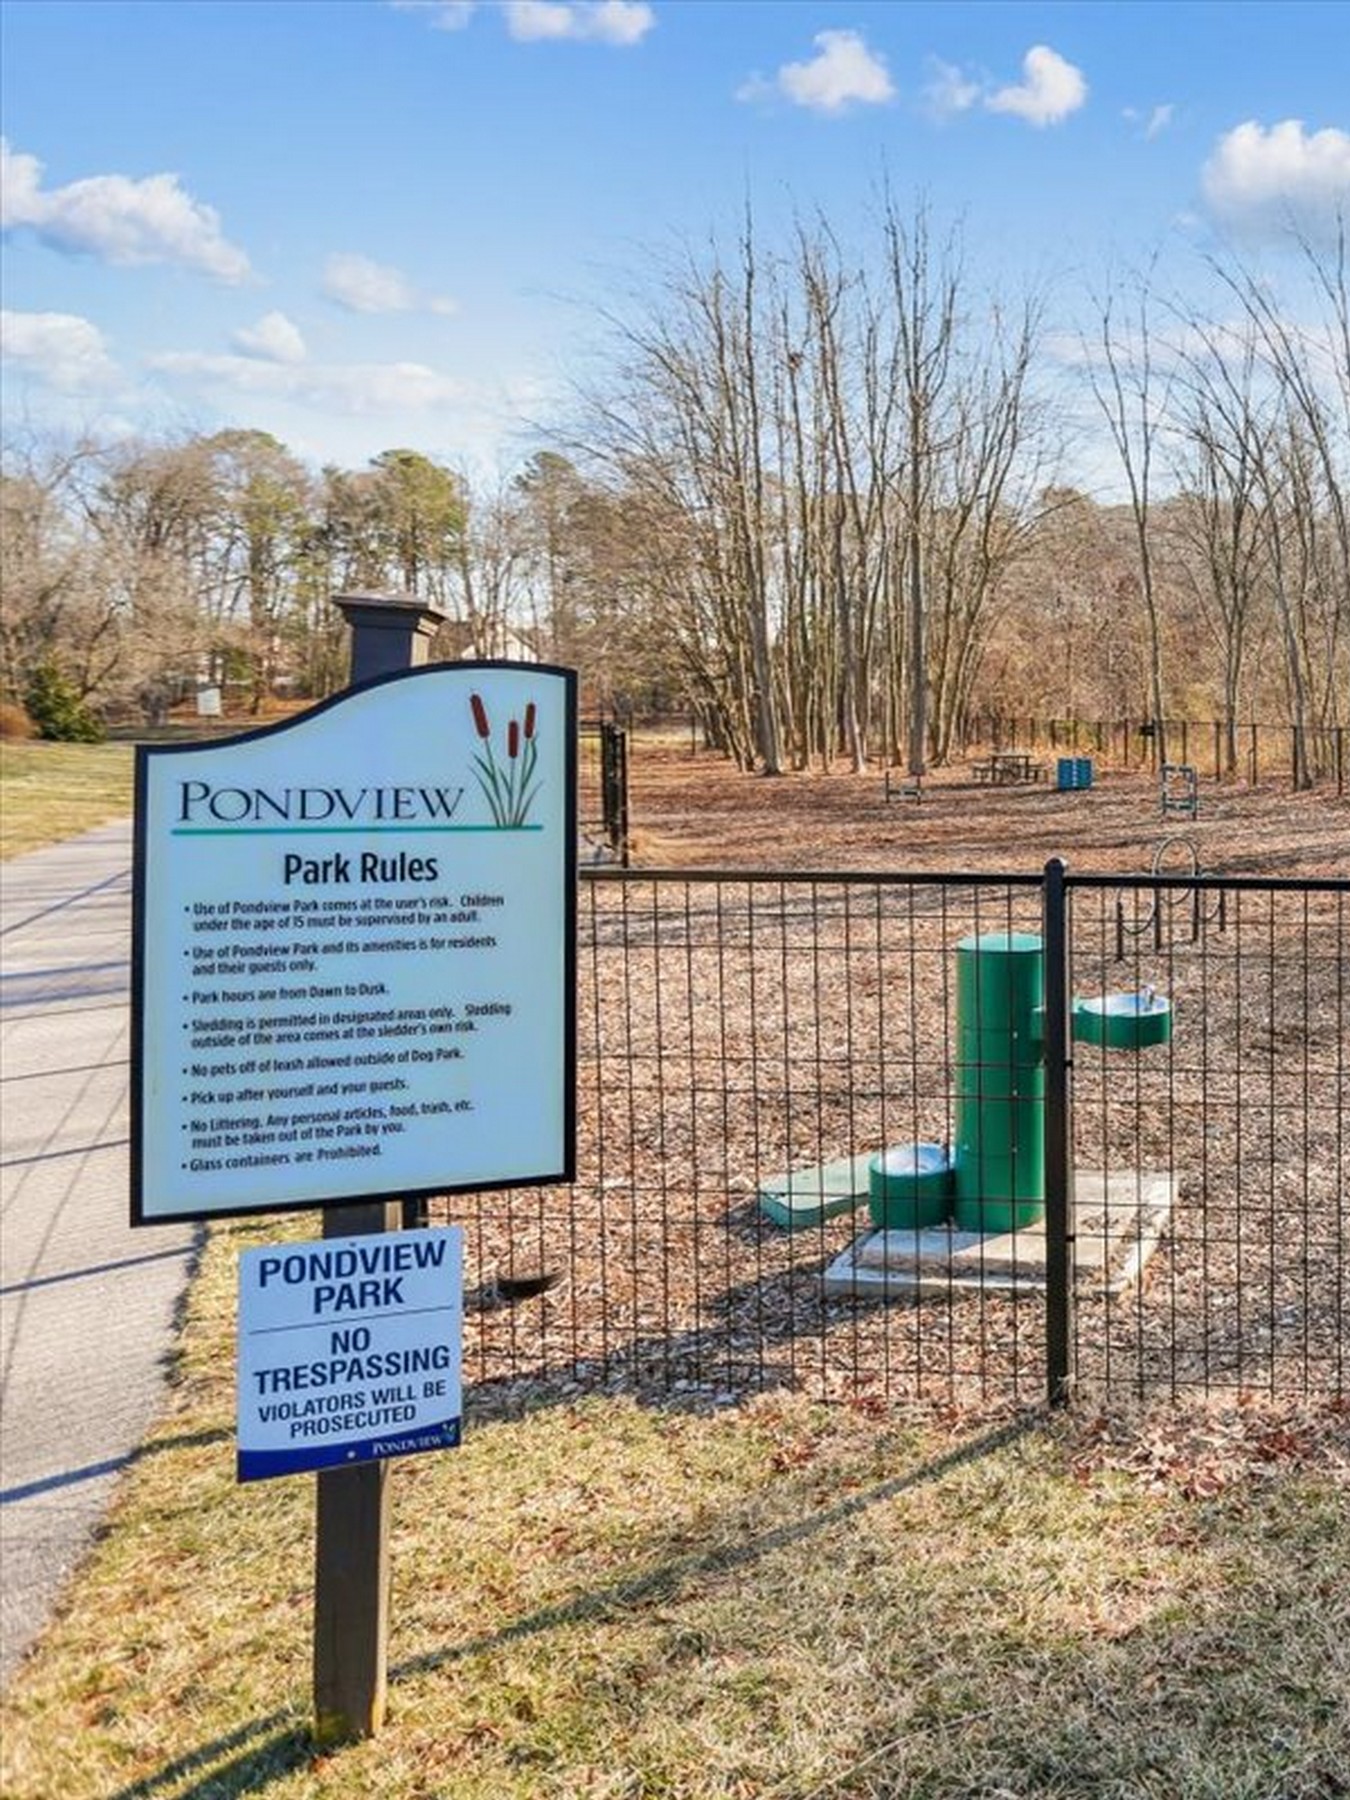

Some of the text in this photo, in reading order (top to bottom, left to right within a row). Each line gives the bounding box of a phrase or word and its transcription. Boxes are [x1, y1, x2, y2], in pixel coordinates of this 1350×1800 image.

[178, 779, 464, 822] PONDVIEW
[283, 852, 438, 884] Park Rules
[193, 894, 504, 915] Use of Pondview Park comes at the user's risk. Children
[193, 918, 228, 931] under
[231, 918, 252, 930] the
[253, 919, 275, 931] age
[277, 917, 290, 928] of
[294, 916, 304, 928] 15
[307, 917, 335, 928] must
[338, 915, 352, 927] be
[356, 912, 415, 926] supervised
[418, 912, 431, 925] by
[433, 913, 447, 923] an
[193, 936, 497, 959] Use of Pondview Park and its amenities is for residents
[192, 959, 317, 976] and their guests only.
[192, 983, 389, 1004] Park hours are from Dawn to Dusk.
[192, 1003, 511, 1032] Sledding is permitted in designated areas only. Sledding
[192, 1021, 478, 1048] outside of the area comes at the sledder's own risk.
[191, 1049, 464, 1077] No pets off of leash allowed outside of Dog Park.
[191, 1078, 409, 1103] Pick up after yourself and your guests.
[191, 1100, 474, 1132] No Littering. Any personal articles, food, trash, etc.
[192, 1135, 222, 1149] must
[225, 1134, 240, 1146] be
[242, 1132, 275, 1145] taken
[278, 1130, 297, 1141] out
[301, 1128, 313, 1140] of
[315, 1126, 334, 1137] the
[336, 1124, 361, 1136] Park
[365, 1123, 379, 1135] by
[190, 1144, 382, 1171] Glass containers are Prohibited.
[259, 1239, 446, 1288] PONDVIEW
[314, 1277, 404, 1314] PARK
[331, 1327, 371, 1355] NO
[253, 1345, 450, 1395] TRESPASSING
[258, 1380, 446, 1423] VIOLATORS WILL BE
[290, 1405, 416, 1438] PROSECUTED
